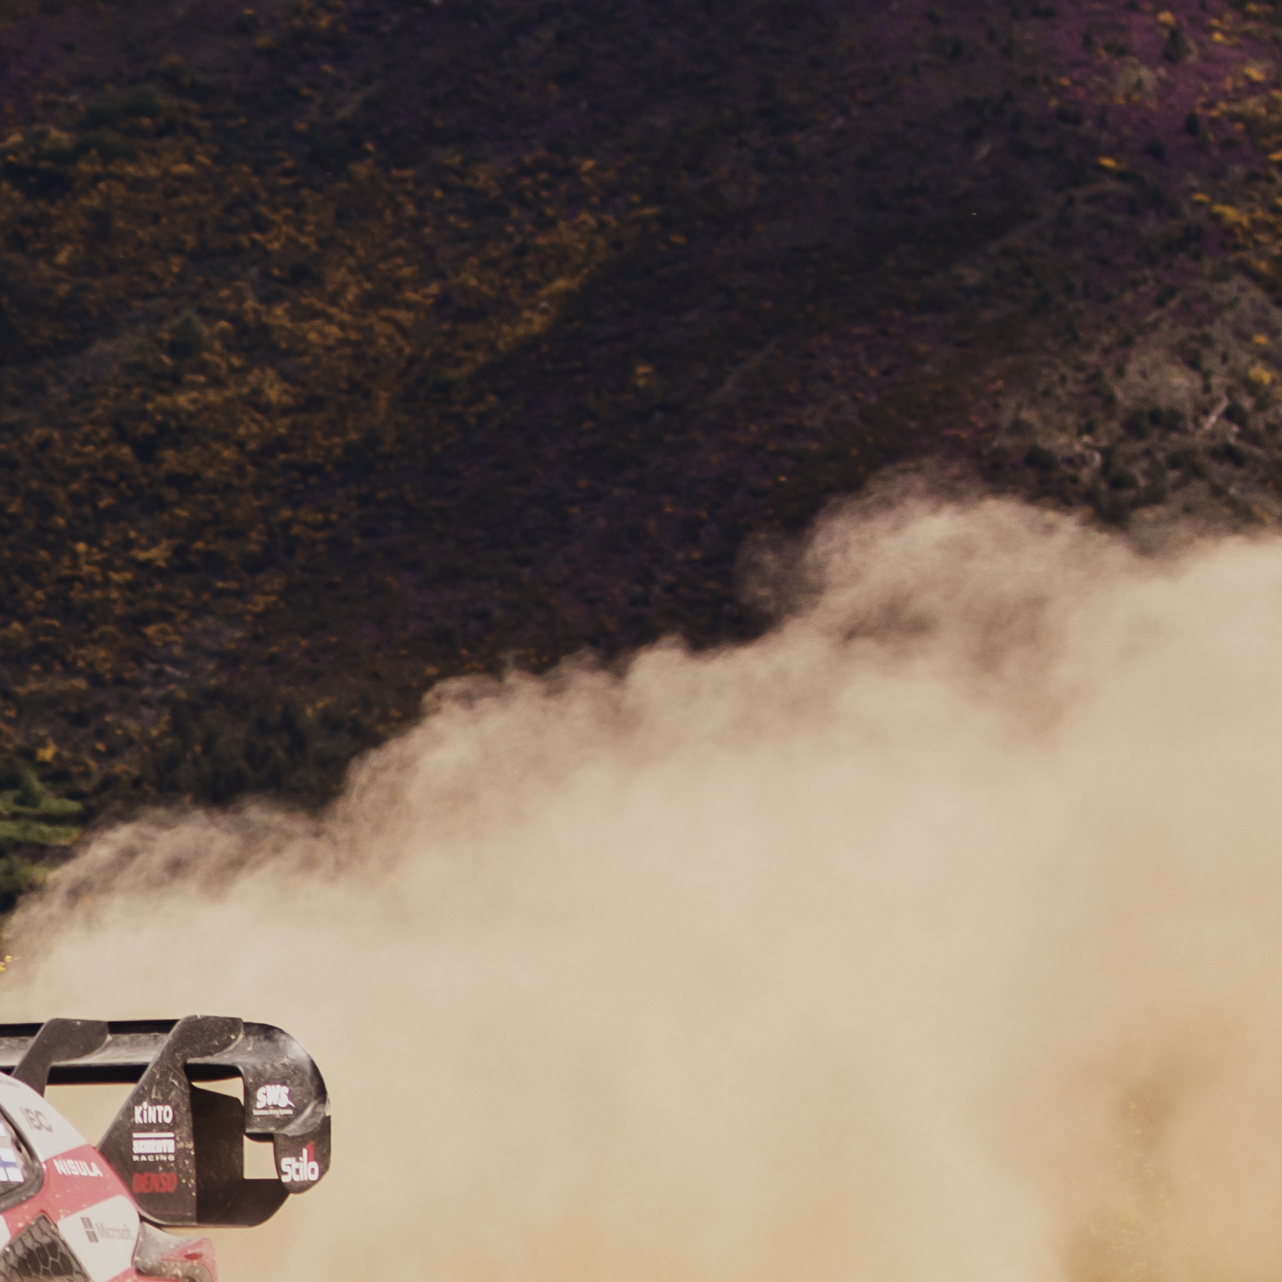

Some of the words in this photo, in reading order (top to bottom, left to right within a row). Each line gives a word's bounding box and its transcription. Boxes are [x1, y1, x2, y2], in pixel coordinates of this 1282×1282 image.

[256, 1084, 296, 1109] SWS
[53, 1158, 104, 1178] NISULA
[281, 1147, 320, 1183] Stilo
